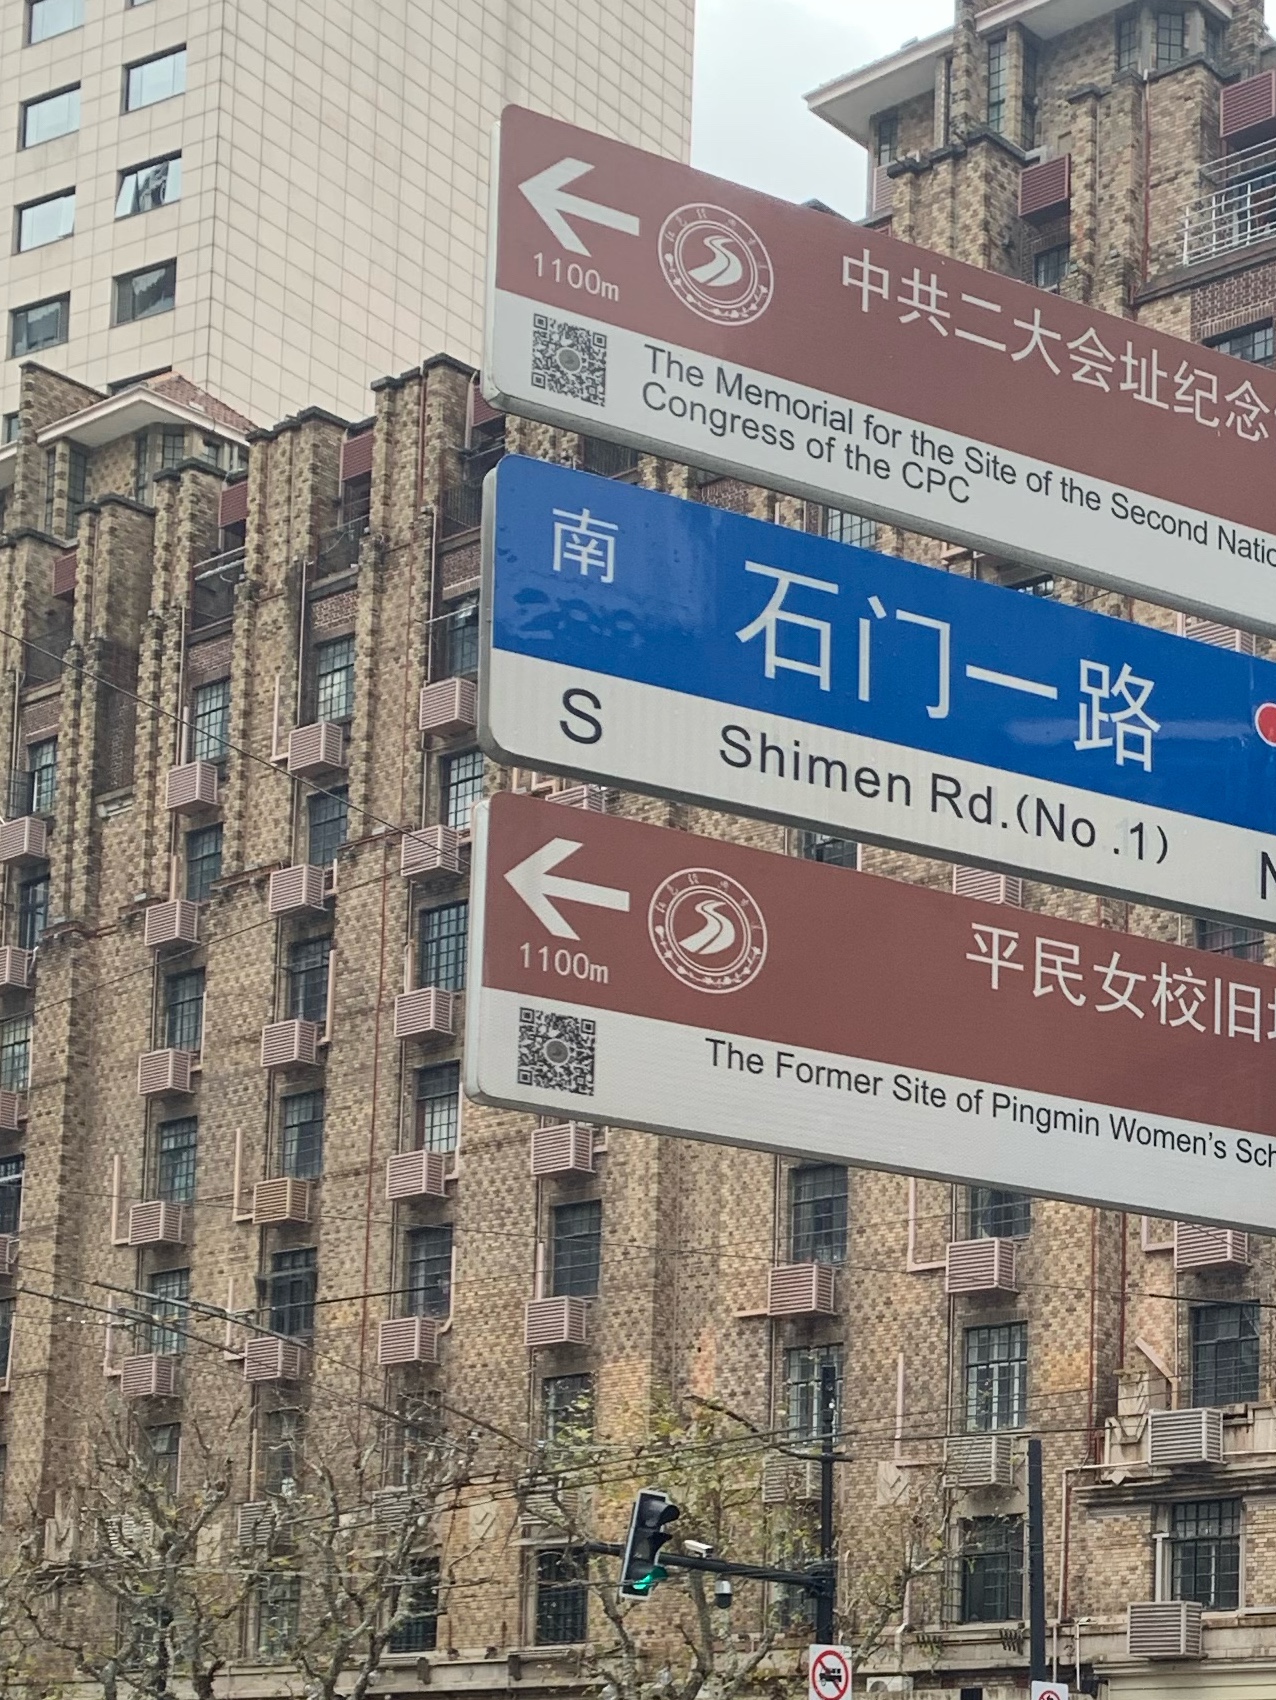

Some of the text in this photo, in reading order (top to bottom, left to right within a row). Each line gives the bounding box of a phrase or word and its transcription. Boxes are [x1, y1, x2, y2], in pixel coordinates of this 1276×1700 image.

[533, 252, 620, 302] 1100m
[642, 382, 970, 504] Congress of the CPC
[645, 344, 703, 386] The
[716, 367, 853, 434] Memorial
[864, 414, 904, 449] for
[911, 425, 955, 467] the
[965, 441, 1019, 484] Site
[1027, 470, 1053, 496] of
[1060, 476, 1103, 513] the
[1111, 493, 1208, 546] Second
[553, 509, 618, 583] 南
[736, 561, 1161, 773] 石门一路
[560, 688, 603, 745] S
[720, 725, 911, 807] Shimen
[520, 942, 609, 983] 1100m
[705, 1038, 764, 1075] The
[777, 1051, 883, 1096] Former
[893, 1074, 947, 1108] Site
[957, 1086, 984, 1113] of
[992, 1092, 1100, 1137] Pingmin
[1110, 1114, 1227, 1160] Women's
